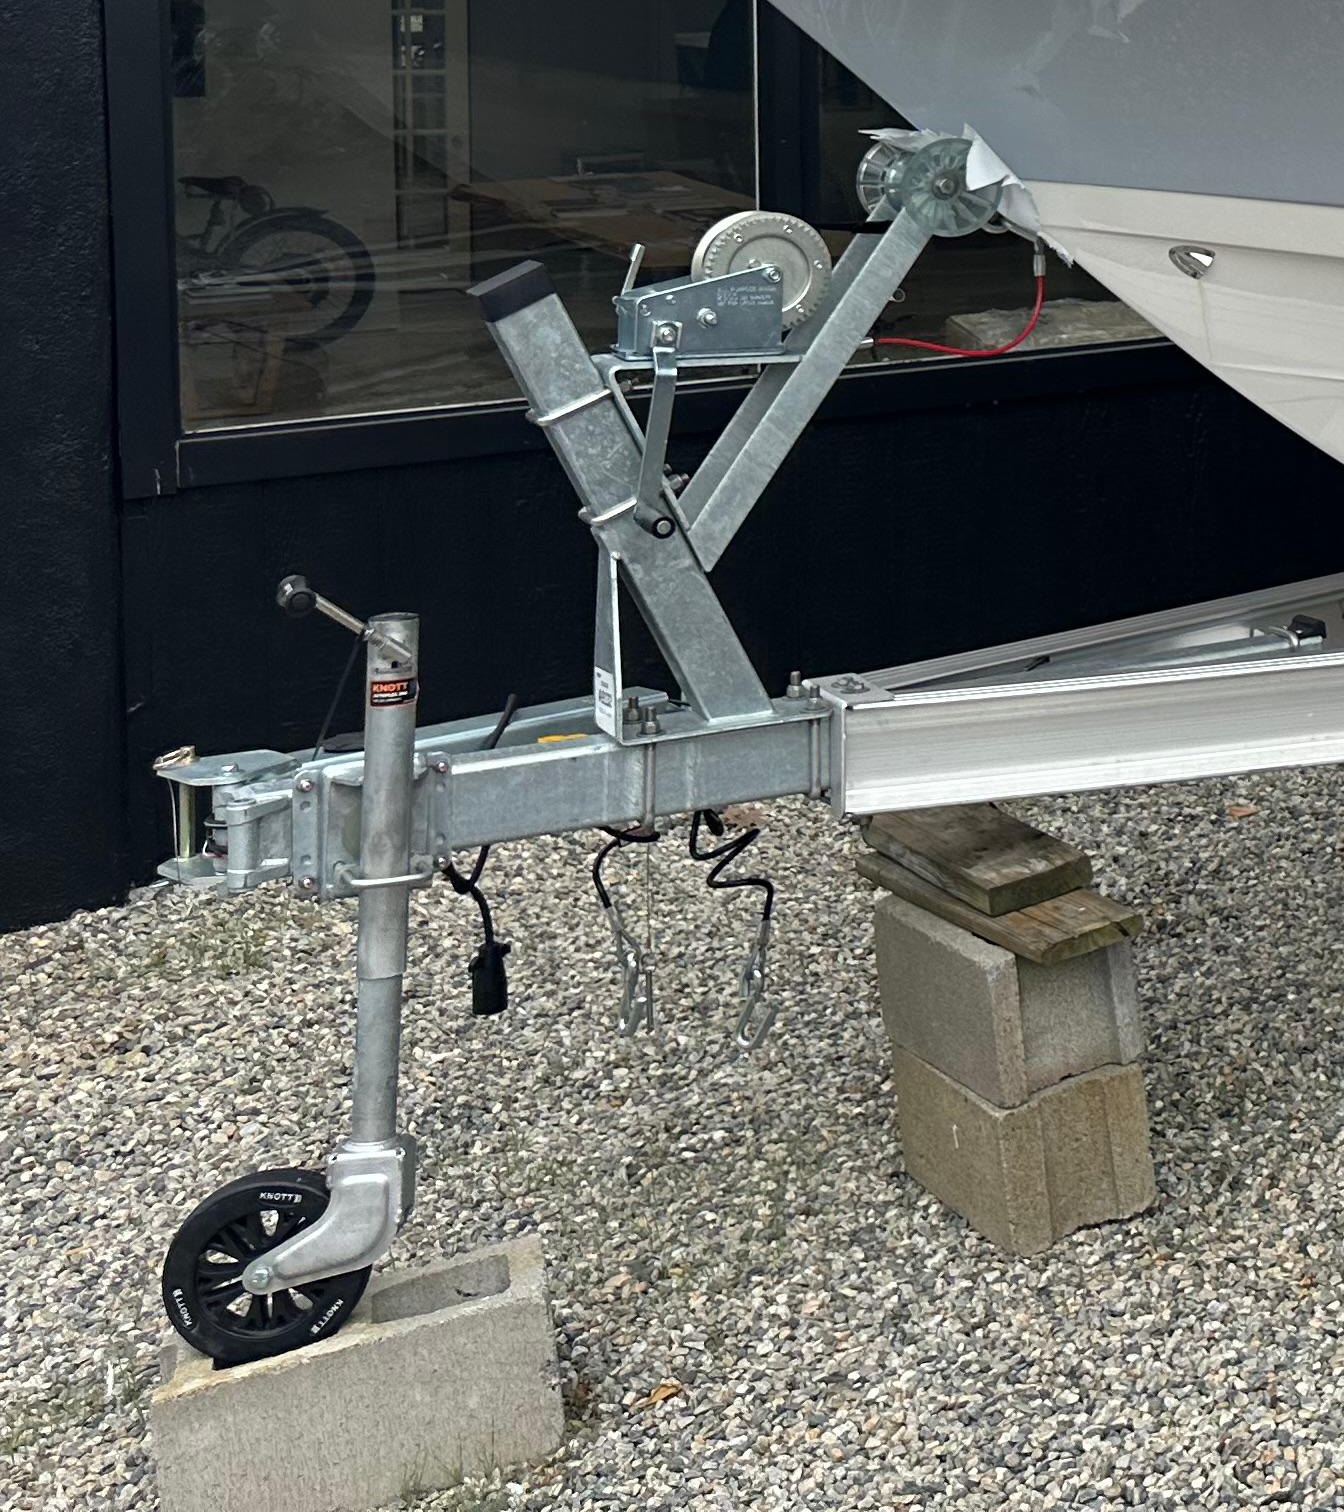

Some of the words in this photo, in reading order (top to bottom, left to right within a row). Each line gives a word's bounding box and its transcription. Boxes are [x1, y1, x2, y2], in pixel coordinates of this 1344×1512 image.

[372, 681, 409, 693] KNOTT
[259, 1191, 295, 1202] KNOTT
[175, 1293, 193, 1328] KNOTT
[317, 1298, 344, 1329] KNOTT
